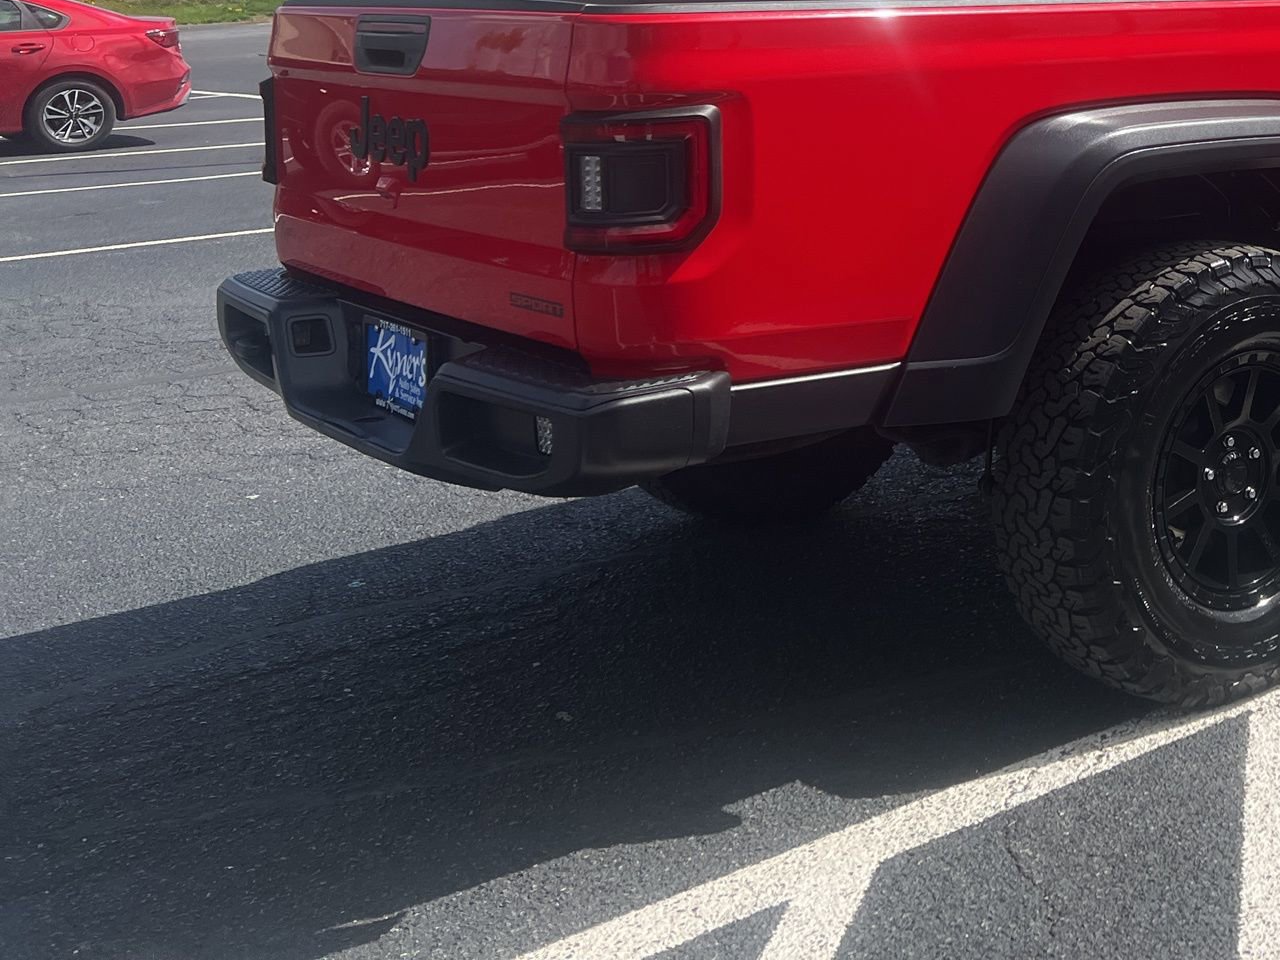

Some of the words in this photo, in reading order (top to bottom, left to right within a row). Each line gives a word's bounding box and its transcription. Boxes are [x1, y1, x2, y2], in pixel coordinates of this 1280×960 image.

[350, 95, 429, 182] Jeep
[510, 291, 564, 319] SPORT
[370, 329, 426, 394] Kyner's
